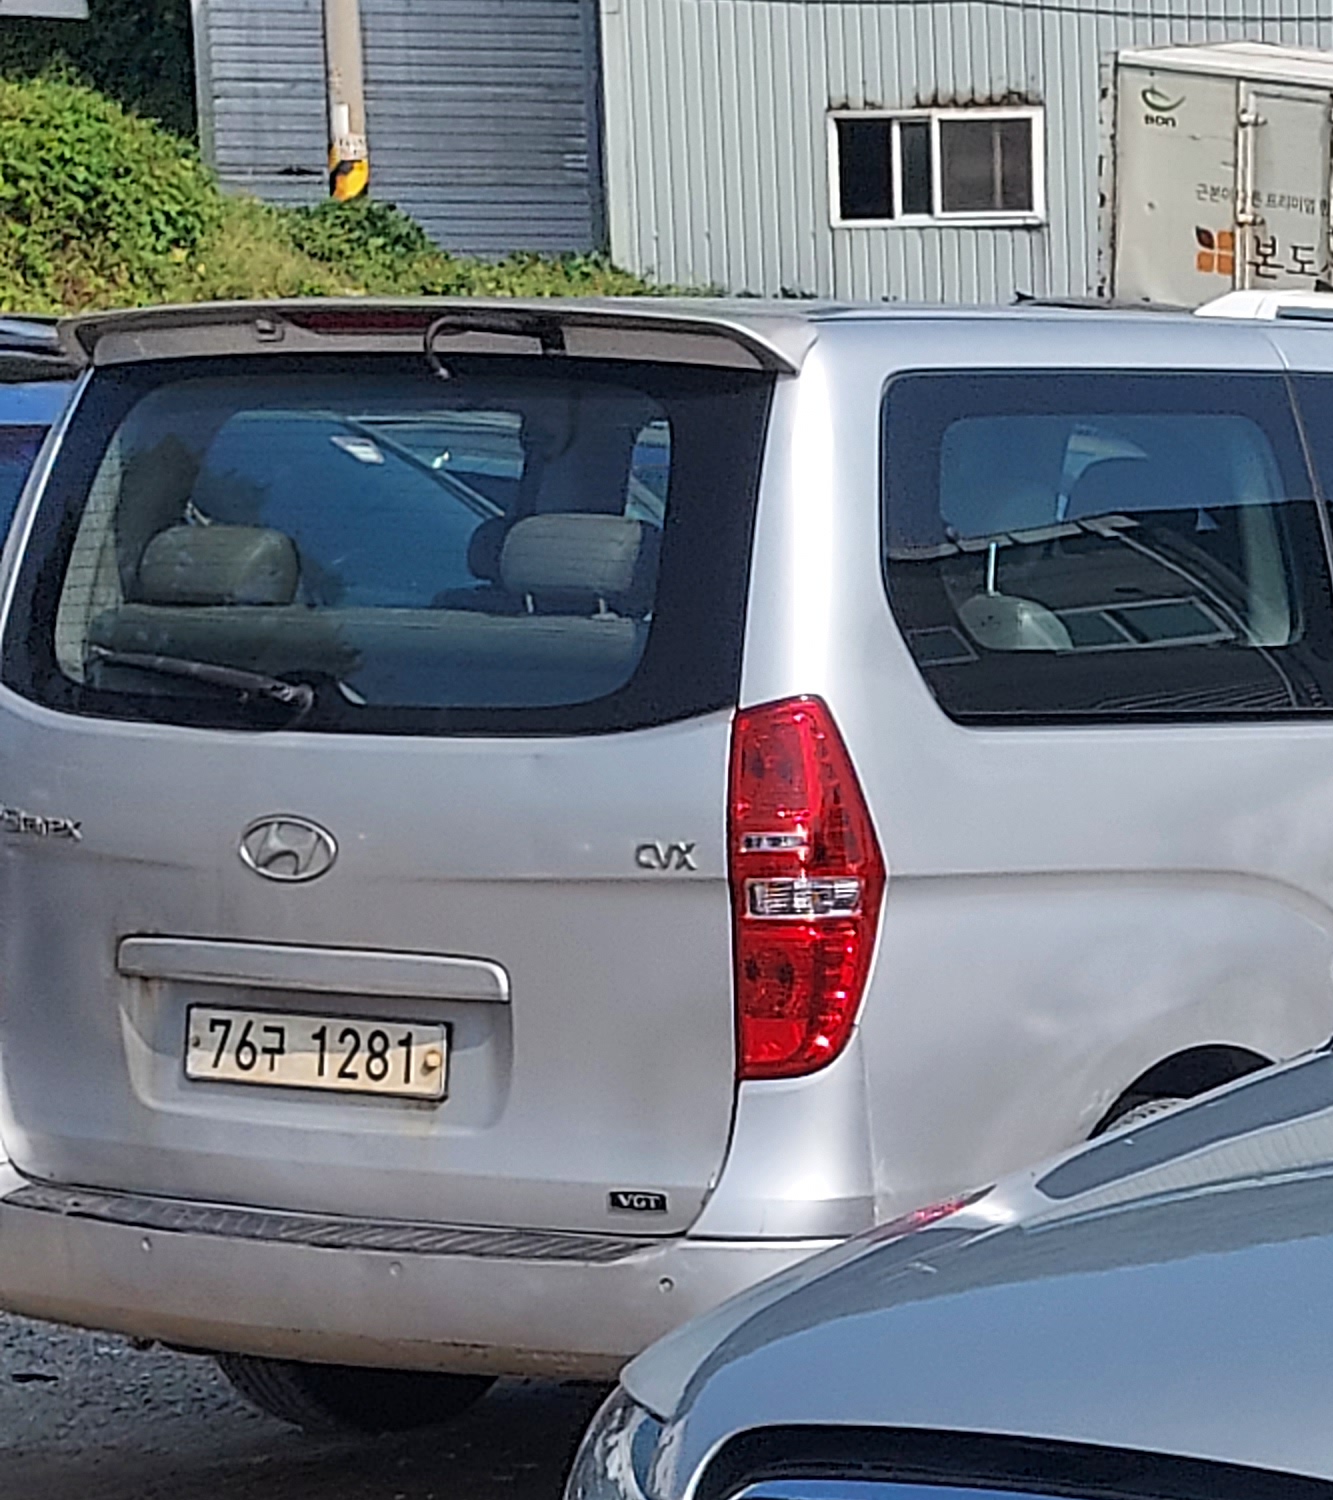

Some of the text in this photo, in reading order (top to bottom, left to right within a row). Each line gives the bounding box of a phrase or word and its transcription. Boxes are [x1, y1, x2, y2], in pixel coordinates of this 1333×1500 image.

[1265, 193, 1315, 215] 프리미엄
[635, 841, 698, 871] CVX
[208, 1018, 413, 1085] 76구 1281
[617, 1193, 660, 1209] VGT
